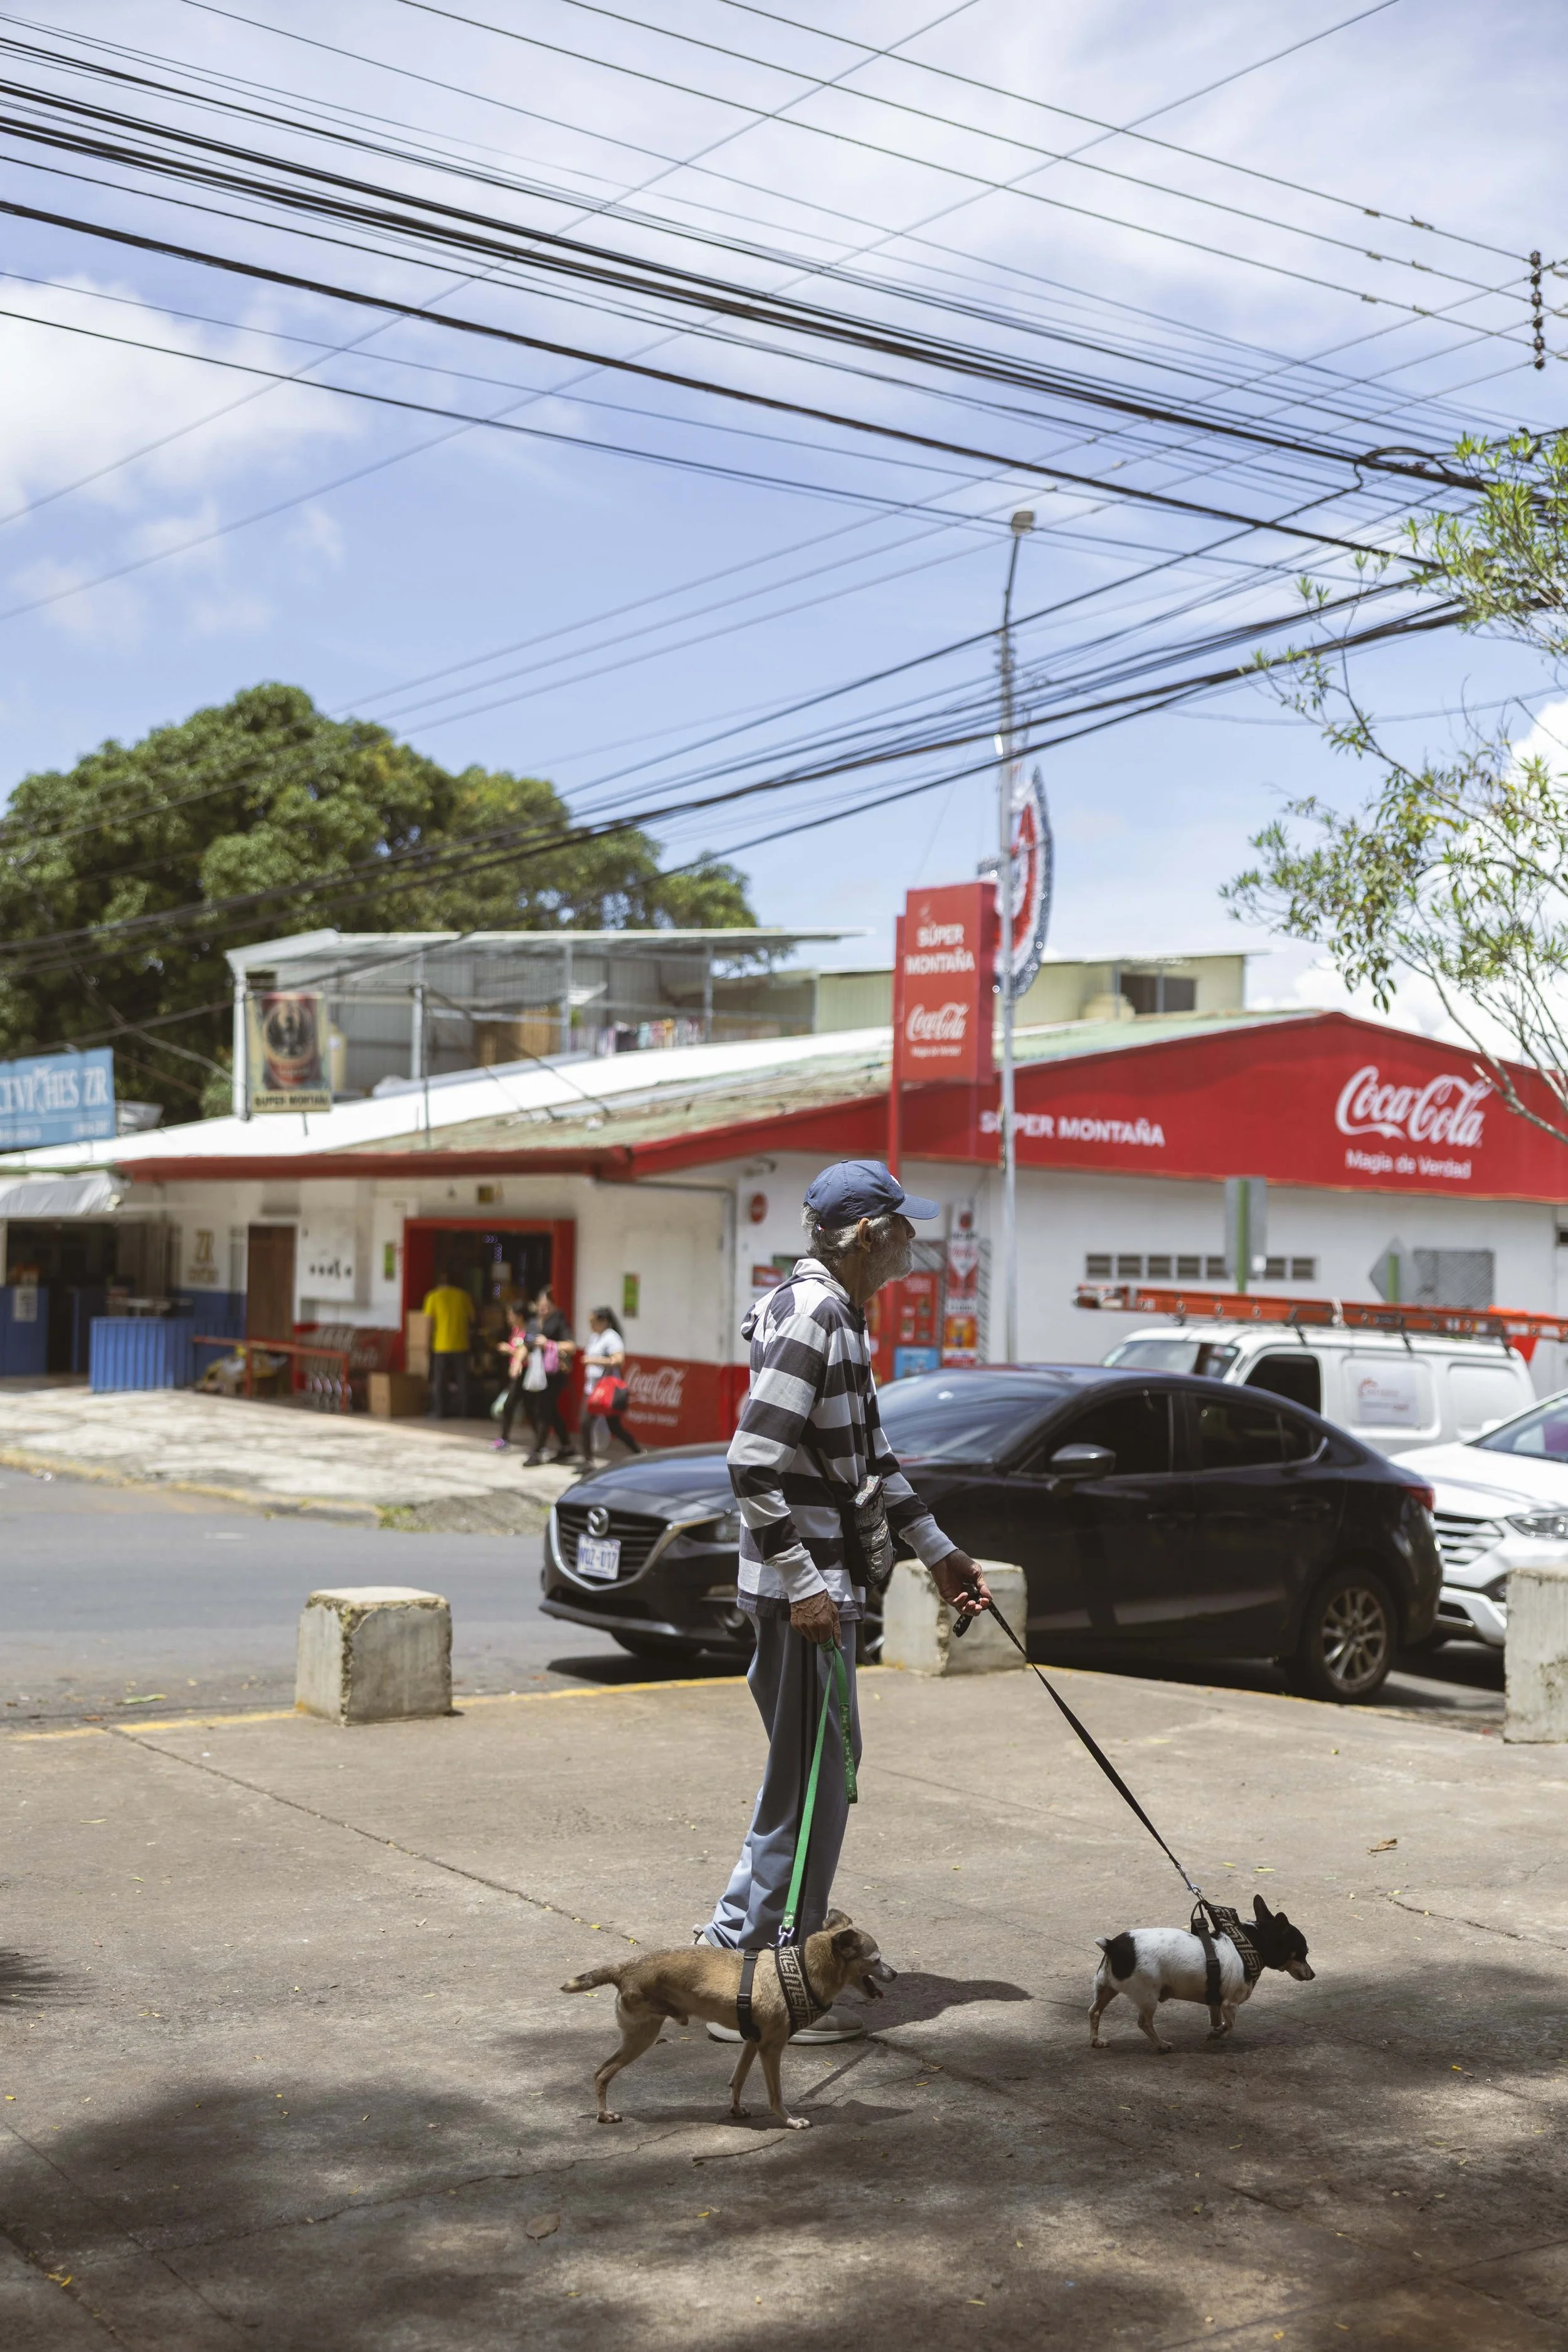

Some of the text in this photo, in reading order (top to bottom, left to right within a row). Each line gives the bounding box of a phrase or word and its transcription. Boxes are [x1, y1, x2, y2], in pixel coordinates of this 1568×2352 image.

[916, 921, 965, 948] SÚPER
[904, 946, 976, 975] MONTAÑA
[0, 1064, 80, 1117] EVICHES
[1335, 1064, 1493, 1148] Coca-Cola
[979, 1110, 1165, 1147] SPER MONTAÑA
[1345, 1147, 1471, 1180] Magia de Verdad
